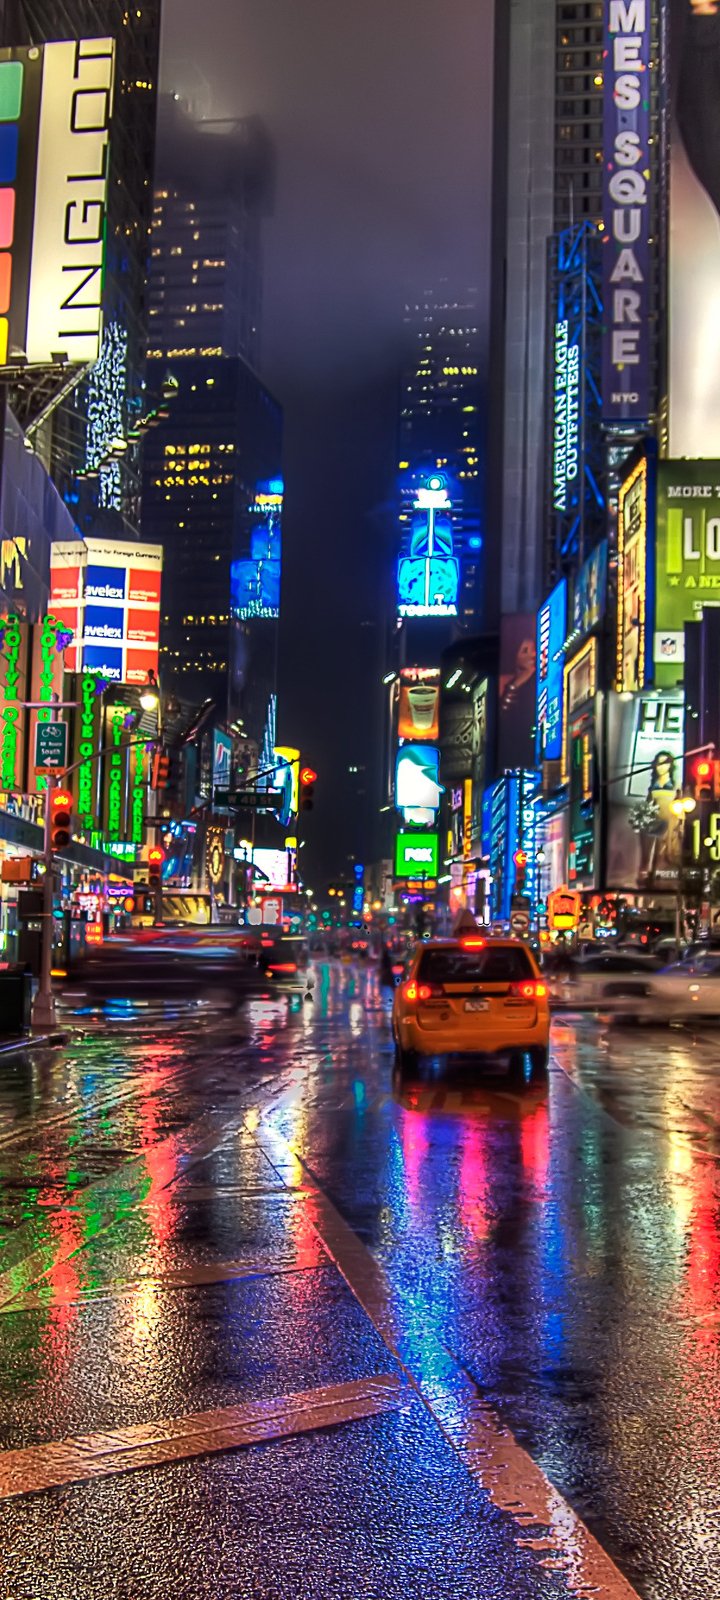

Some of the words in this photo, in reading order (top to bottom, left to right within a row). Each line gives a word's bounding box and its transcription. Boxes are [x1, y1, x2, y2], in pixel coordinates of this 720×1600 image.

[58, 39, 113, 339] INGLOT
[608, 130, 648, 364] SQUARE
[554, 319, 569, 392] EAGLE
[566, 344, 579, 480] OUTFITTERS
[611, 391, 639, 404] NYC
[553, 393, 567, 511] AMERICAN
[668, 486, 712, 498] MORE
[113, 550, 134, 558] Foreign
[135, 551, 161, 562] Currency
[685, 575, 698, 588] A
[398, 604, 458, 617] TOSHIBA
[82, 680, 96, 739] OLIVE
[41, 747, 60, 755] South
[112, 715, 124, 766] OLIE
[108, 768, 122, 831] GARDEN
[227, 795, 237, 804] W
